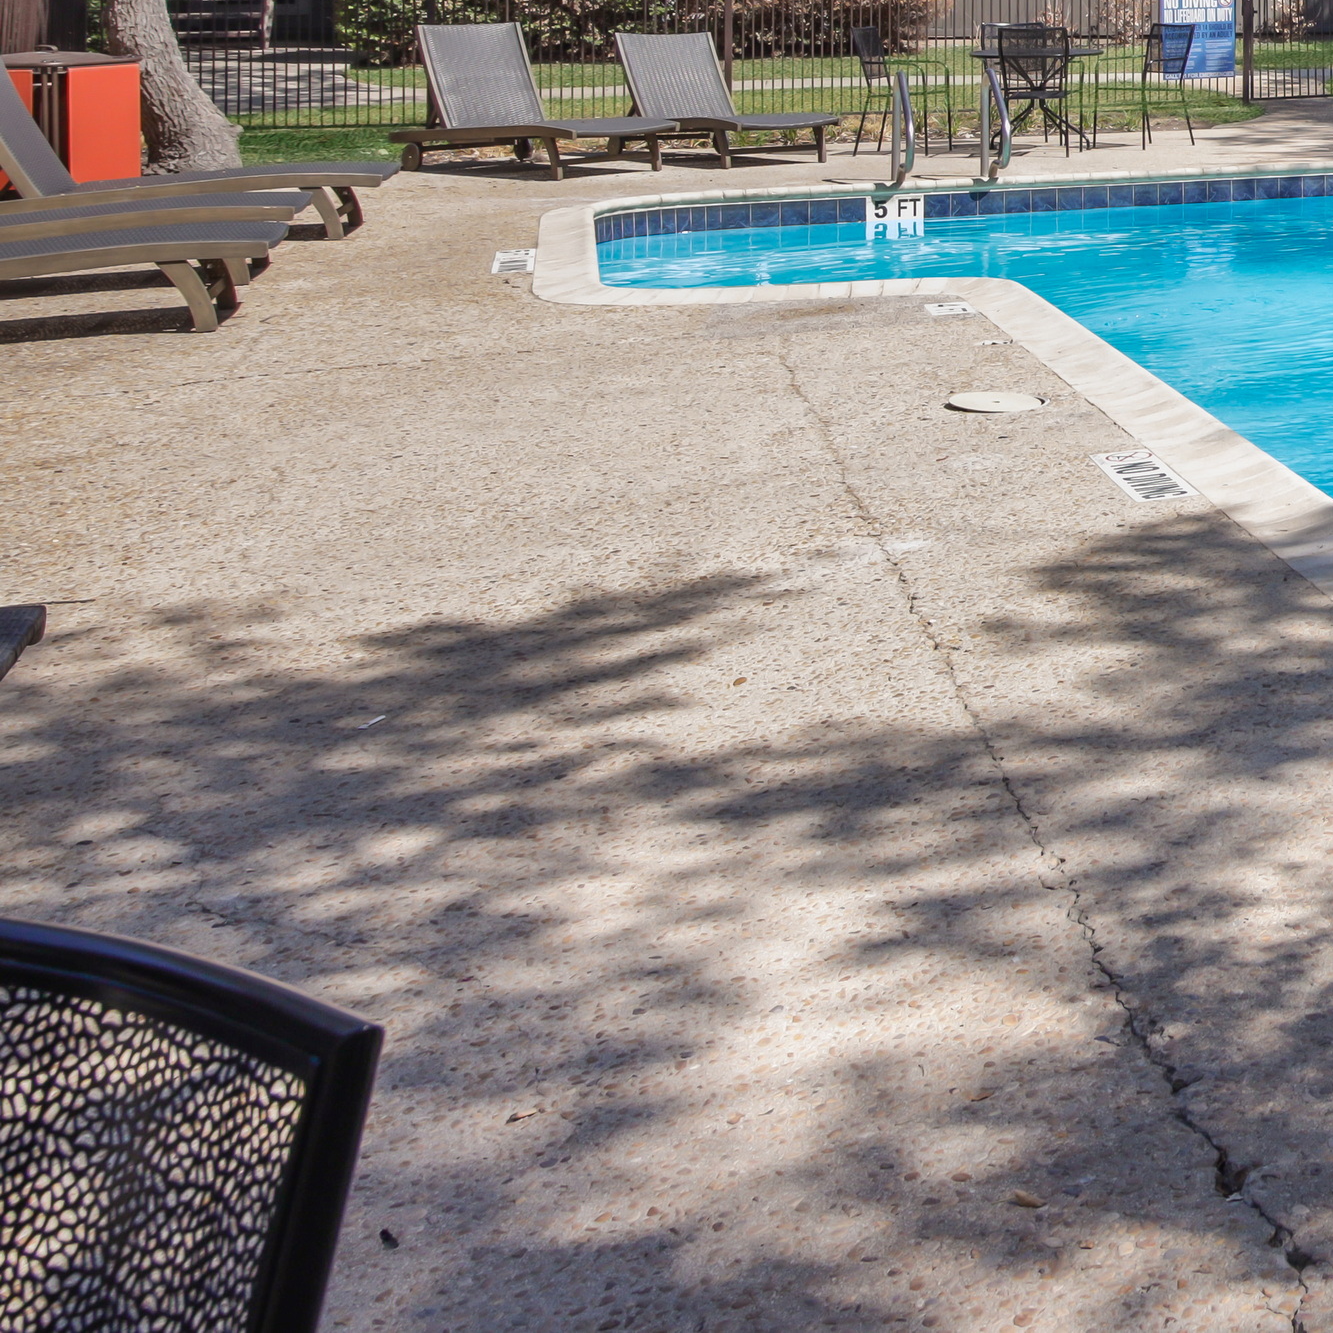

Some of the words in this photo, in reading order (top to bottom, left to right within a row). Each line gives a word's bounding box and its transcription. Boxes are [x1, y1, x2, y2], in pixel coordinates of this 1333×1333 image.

[1164, 9, 1173, 24] NO
[1207, 8, 1216, 23] ON
[1217, 7, 1233, 22] DUTY
[874, 200, 888, 218] 5
[898, 198, 920, 217] FT
[1110, 460, 1160, 475] NO
[1122, 473, 1188, 499] DIVING
